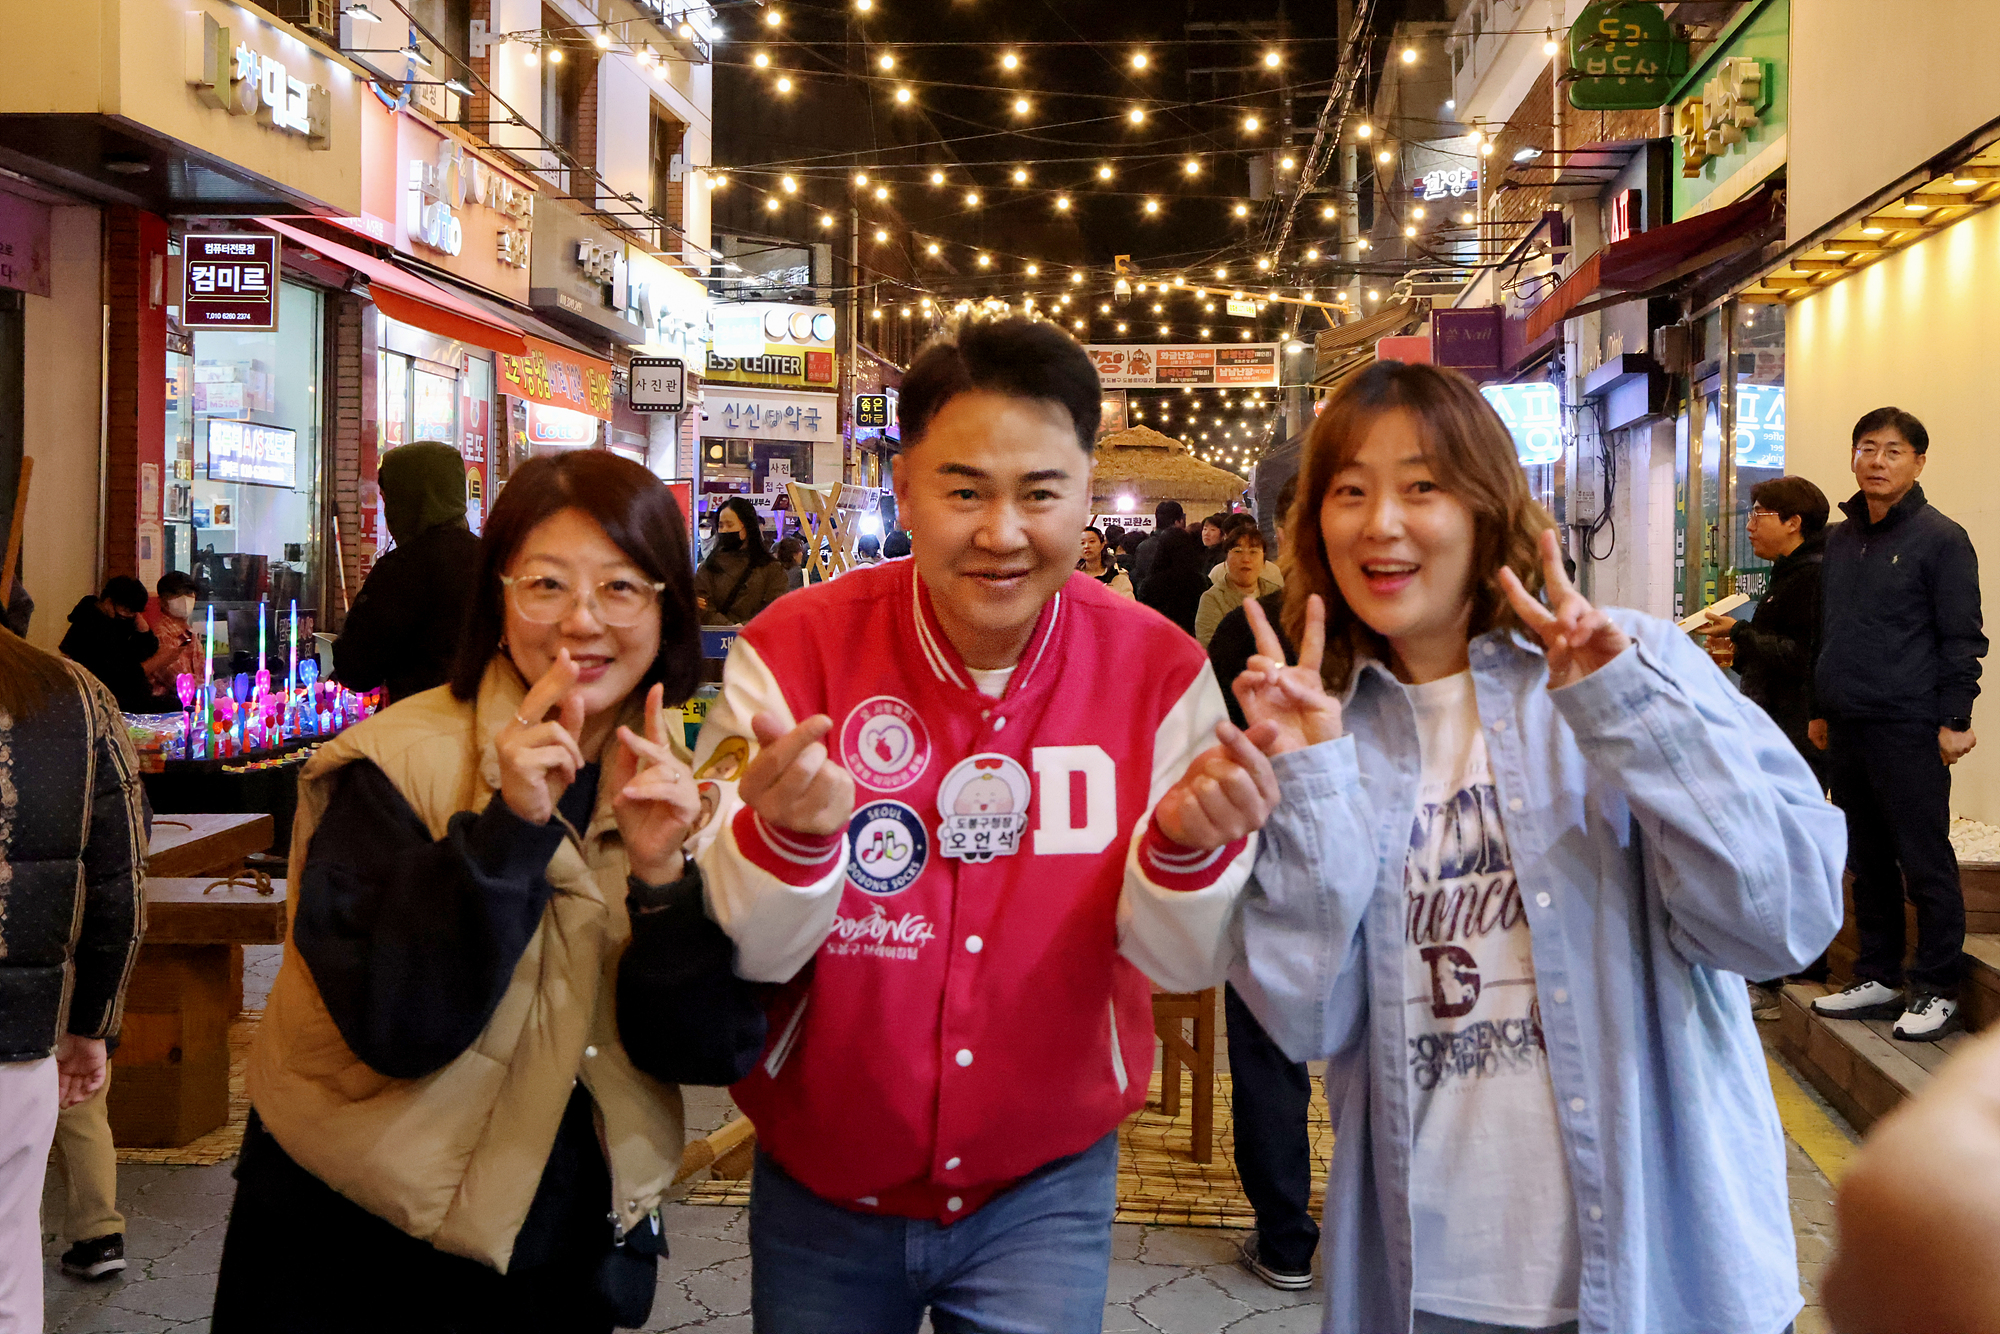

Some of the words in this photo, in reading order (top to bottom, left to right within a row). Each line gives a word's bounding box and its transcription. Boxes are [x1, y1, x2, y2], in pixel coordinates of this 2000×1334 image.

[1586, 55, 1659, 85] 부동산
[1423, 167, 1473, 201] 한양
[409, 190, 462, 257] Lotto
[204, 243, 256, 255] 컴퓨터전문점
[191, 265, 267, 293] 컴미르
[1463, 328, 1492, 341] Nail
[706, 350, 738, 371] ESS
[742, 353, 802, 377] CENTER
[635, 378, 677, 392] 사진관
[861, 397, 883, 413] 좋은
[721, 402, 822, 432] 신신(당)약국
[860, 414, 884, 424] 하루
[536, 422, 584, 439] Lotto
[464, 432, 484, 462] 로또
[771, 462, 789, 474] 사전
[765, 481, 785, 494] 접수
[1124, 516, 1152, 527] 교환소
[1032, 745, 1118, 855] D
[867, 806, 902, 820] SEOUL
[949, 831, 1014, 850] 오언석
[891, 861, 920, 889] SOCKS
